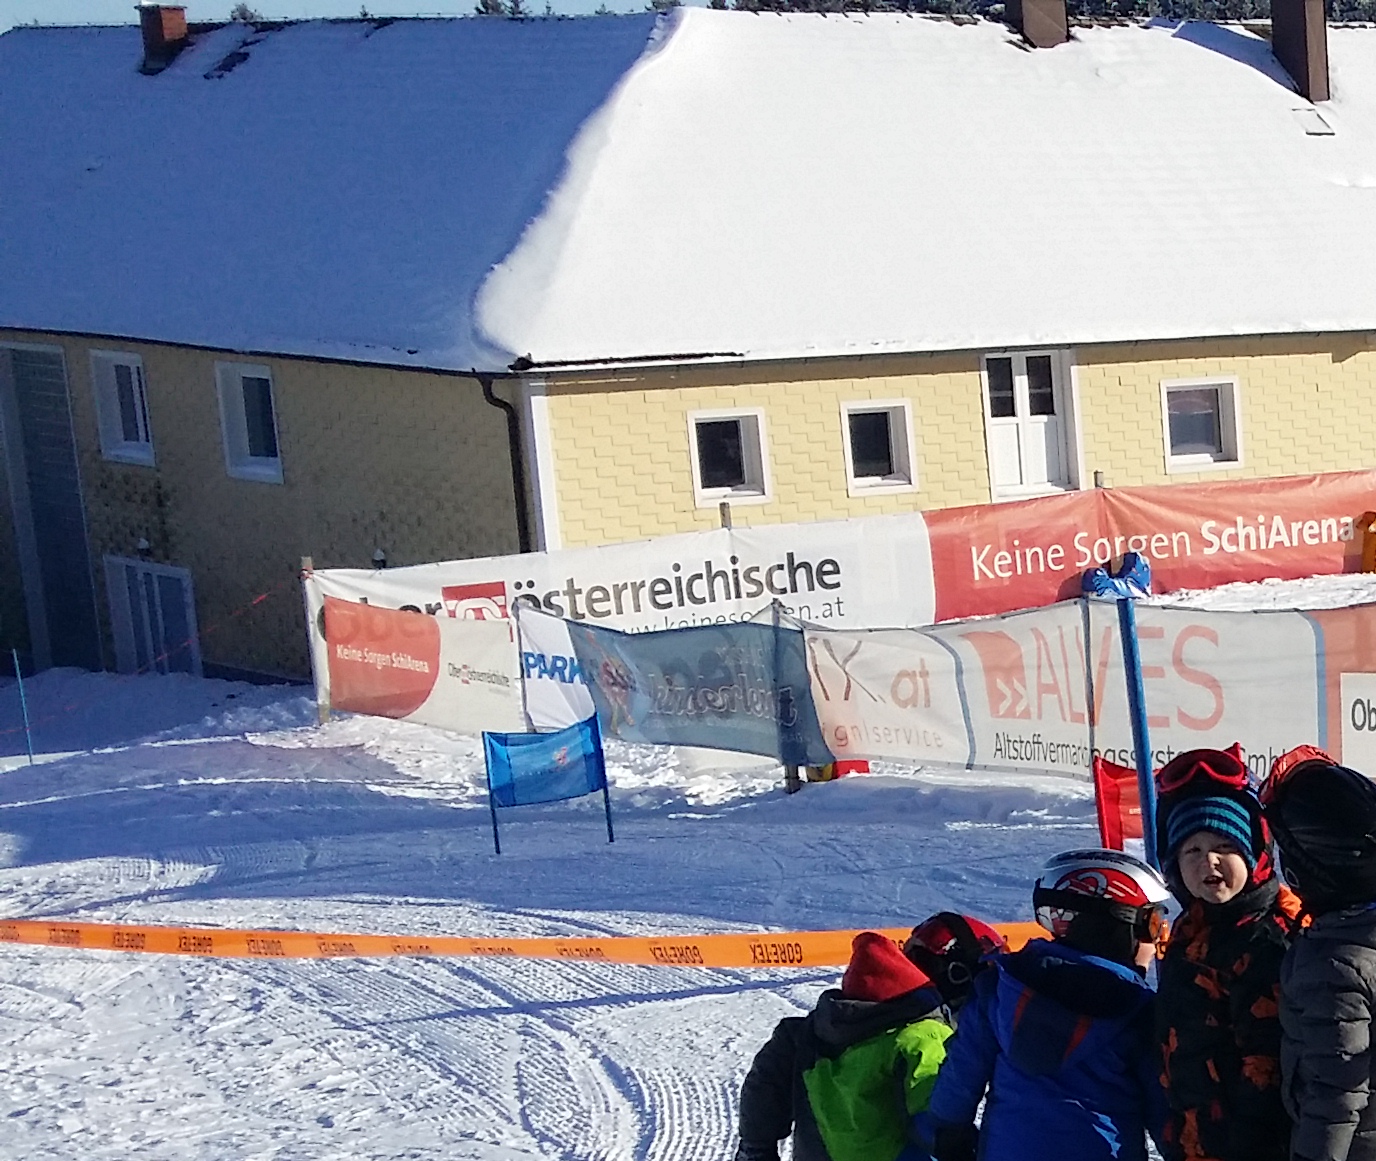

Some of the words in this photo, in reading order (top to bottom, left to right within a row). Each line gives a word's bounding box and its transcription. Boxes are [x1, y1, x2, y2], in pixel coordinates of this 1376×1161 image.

[972, 540, 1065, 581] Keine
[1201, 513, 1355, 555] SchiArena
[750, 943, 804, 964] GORE-TEX
